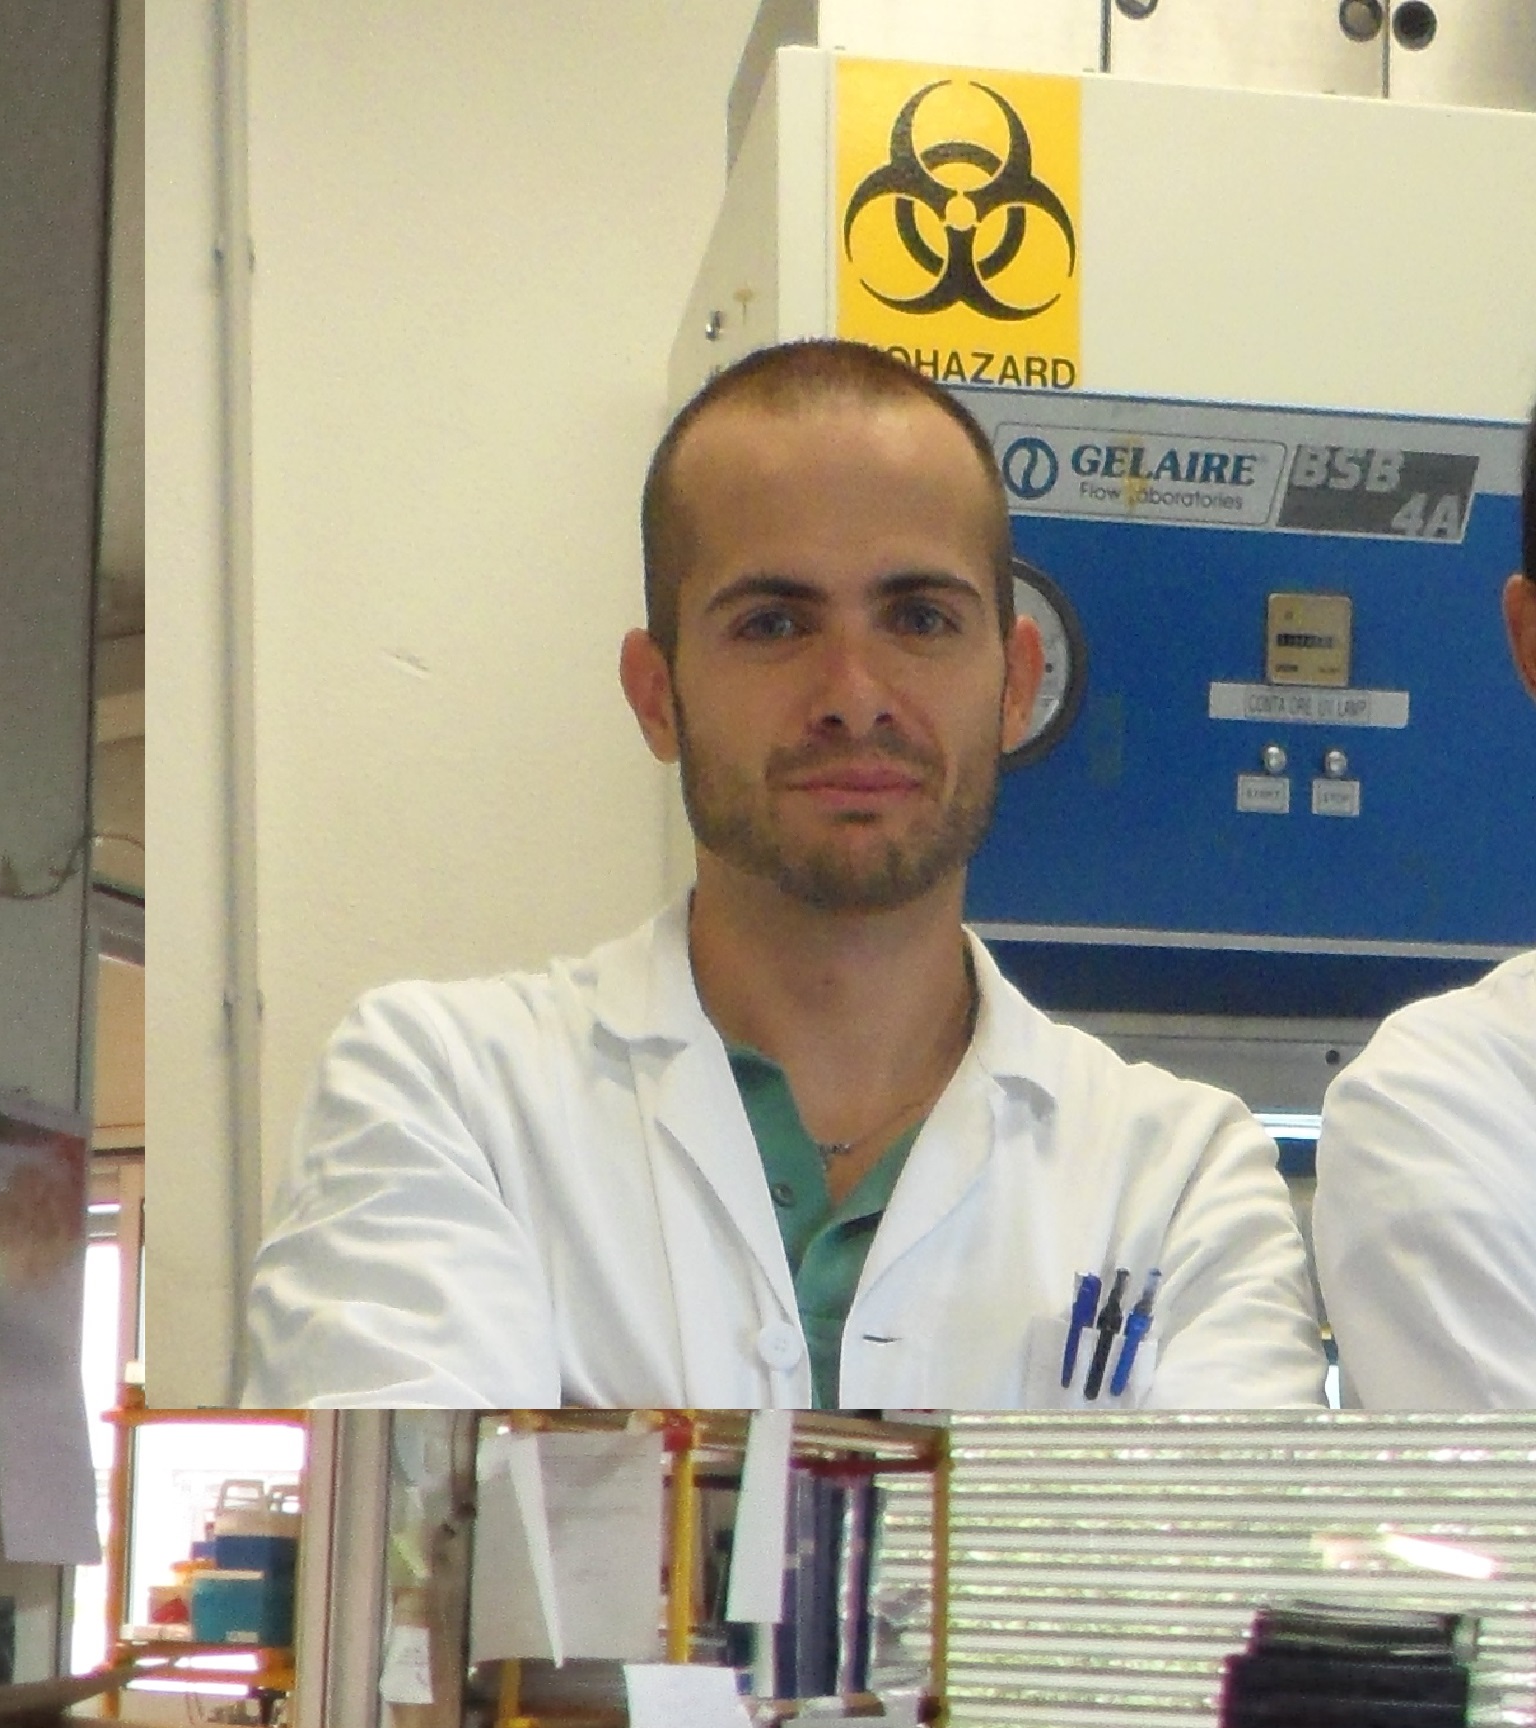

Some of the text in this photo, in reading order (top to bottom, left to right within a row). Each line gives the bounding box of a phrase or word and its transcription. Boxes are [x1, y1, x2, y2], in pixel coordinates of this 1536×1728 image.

[1071, 444, 1257, 486] GELAIRE
[1292, 446, 1405, 493] BSB
[1079, 481, 1243, 510] Flow aboratories
[1391, 492, 1462, 540] 4A
